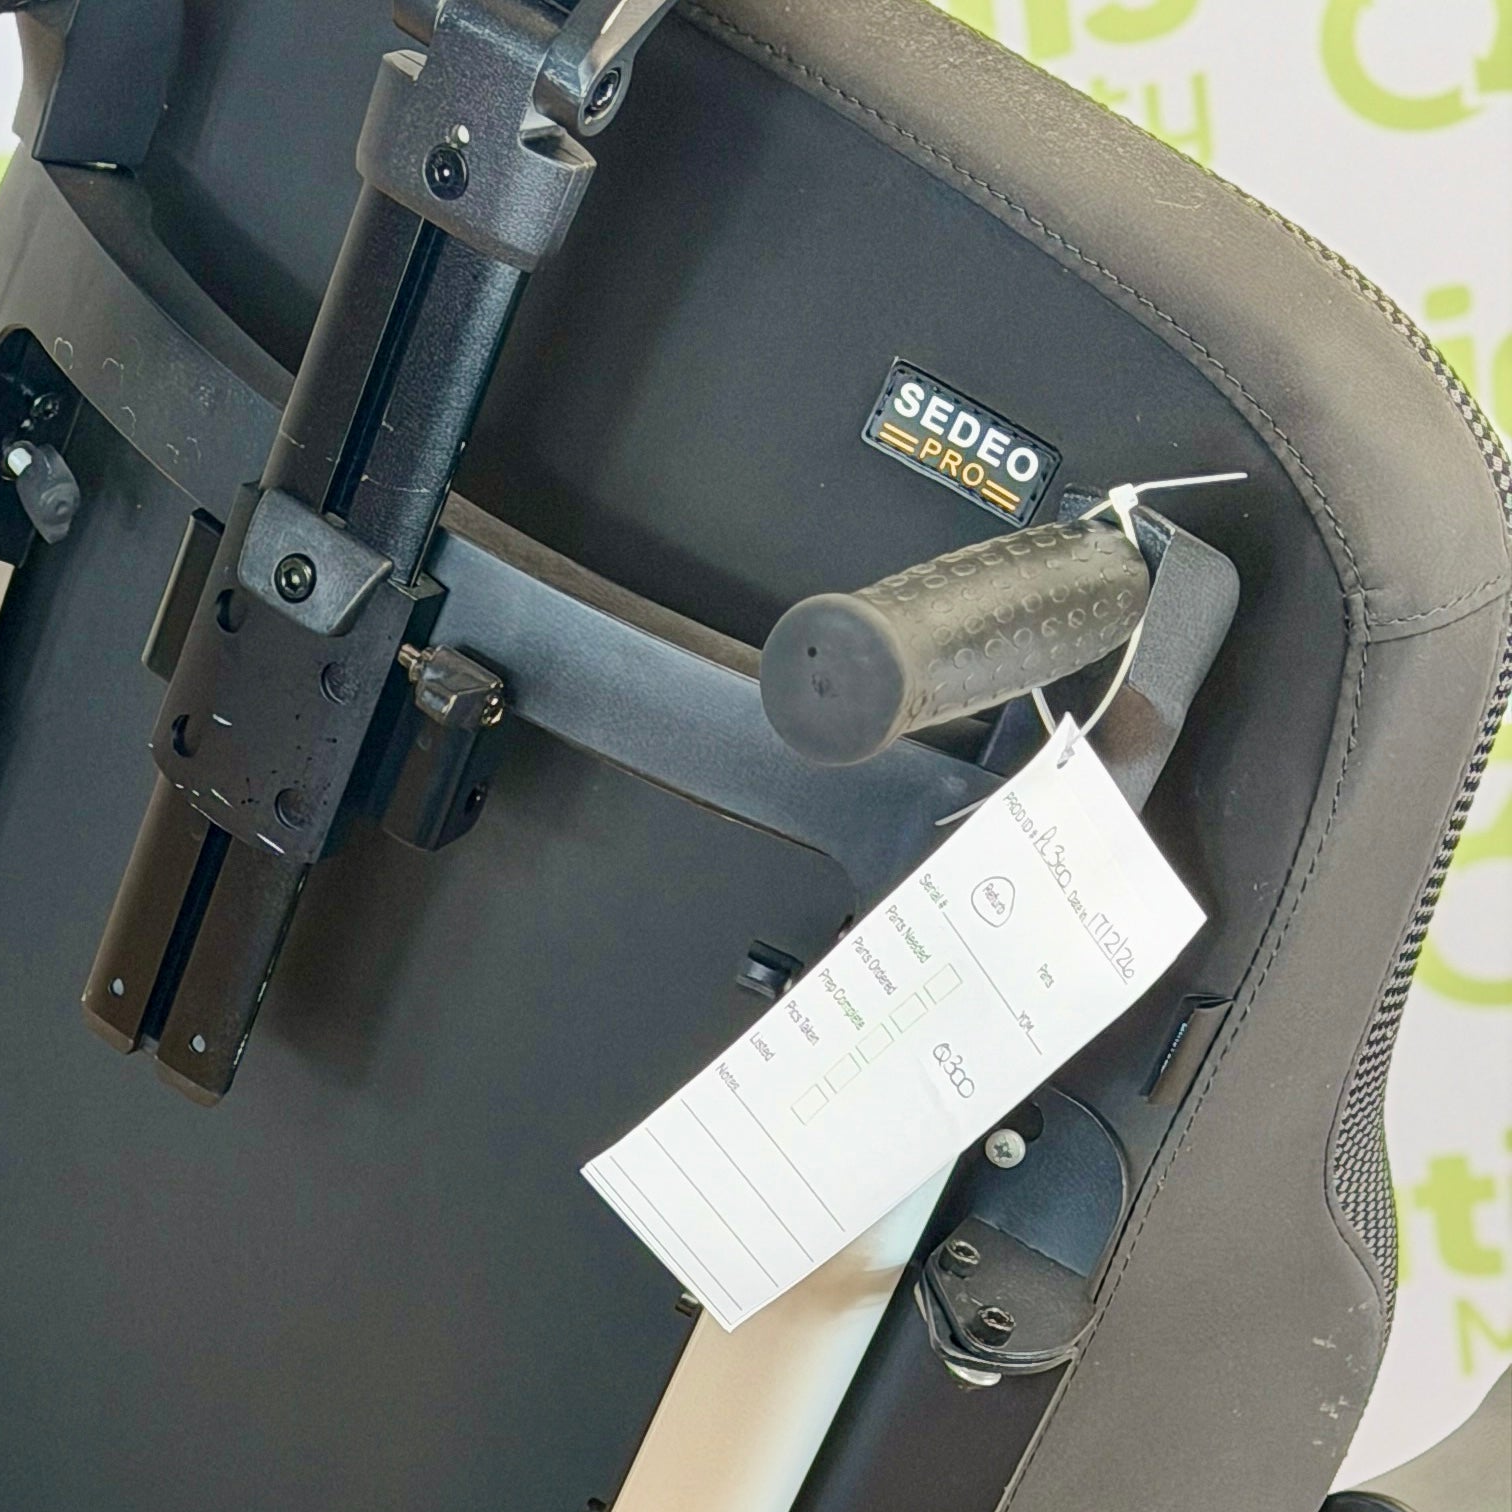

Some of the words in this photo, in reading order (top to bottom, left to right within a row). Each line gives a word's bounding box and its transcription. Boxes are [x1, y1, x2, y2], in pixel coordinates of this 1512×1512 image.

[893, 382, 1039, 482] SEDEO
[919, 437, 985, 487] PRO
[1003, 791, 1027, 822] PROD
[919, 873, 944, 904] Serial
[982, 882, 1006, 916] Refurb
[885, 904, 904, 932] Parts
[903, 926, 932, 965] Needed
[1088, 911, 1136, 980] 17/2/26
[852, 936, 873, 965] Parts
[867, 959, 897, 996] Ordered
[1037, 963, 1055, 989] Parts
[785, 1000, 804, 1025] Pics
[797, 1016, 820, 1047] Taken
[819, 968, 839, 995] Prep
[833, 989, 866, 1031] Complete
[749, 1032, 776, 1063] Listed
[932, 1043, 975, 1099] Q300
[715, 1062, 741, 1092] Notes
